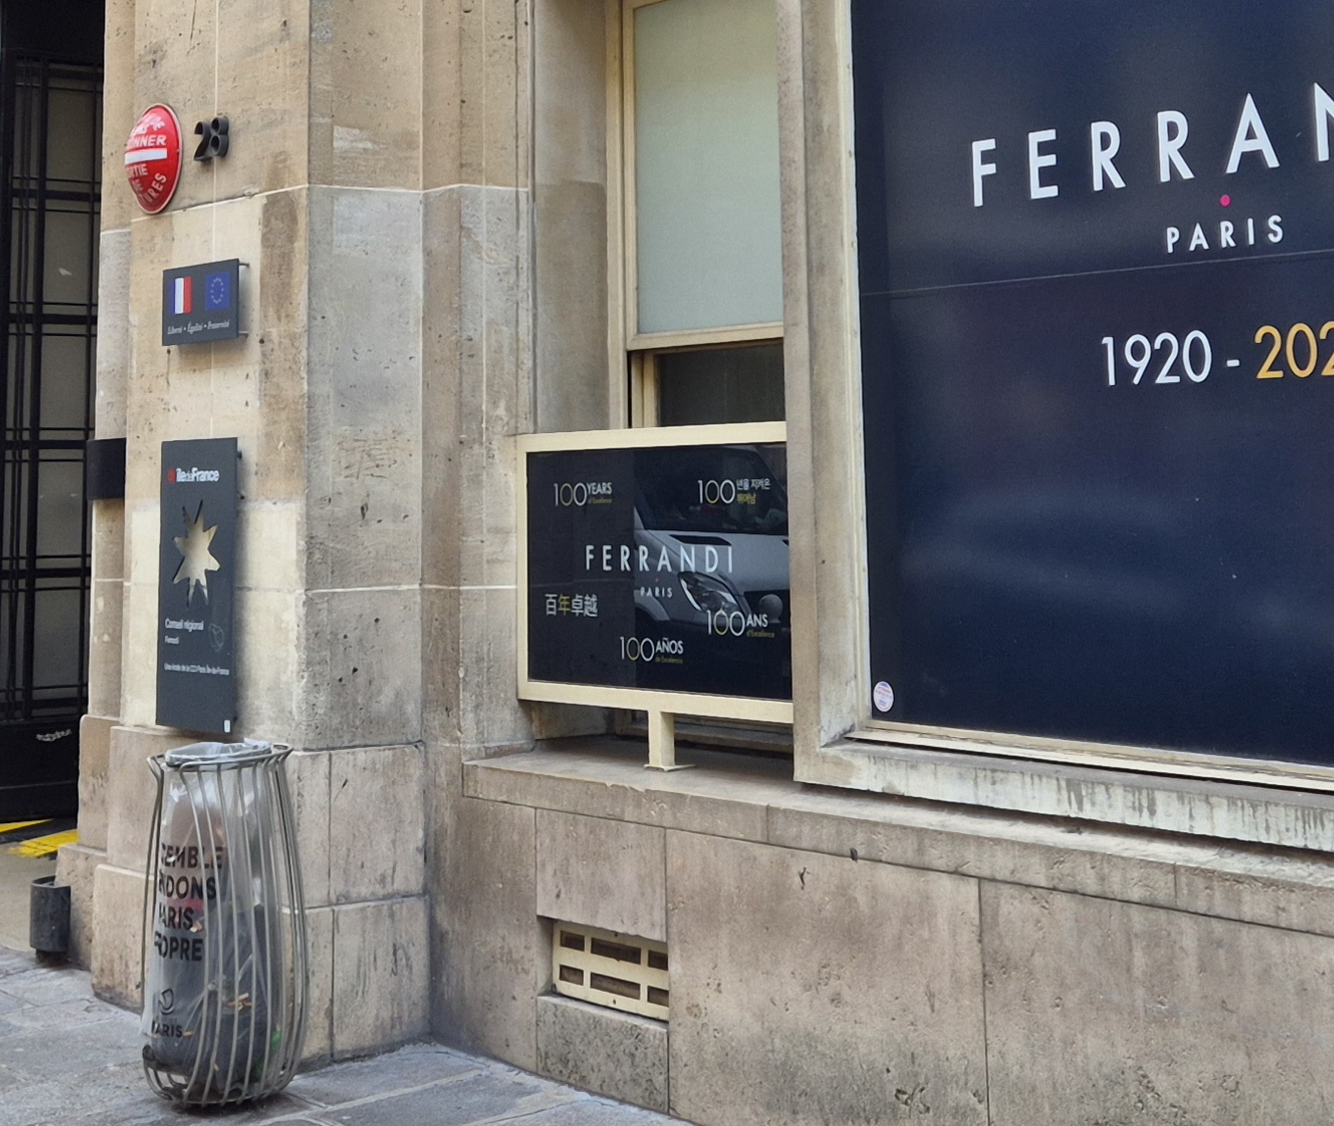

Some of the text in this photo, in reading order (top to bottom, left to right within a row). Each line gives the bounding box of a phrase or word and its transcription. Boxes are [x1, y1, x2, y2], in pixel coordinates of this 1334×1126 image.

[193, 115, 230, 162] 28
[1166, 214, 1284, 253] PARIS
[585, 544, 734, 573] FERRANDI
[545, 593, 598, 617] 百年卓越
[640, 586, 673, 598] PARIS
